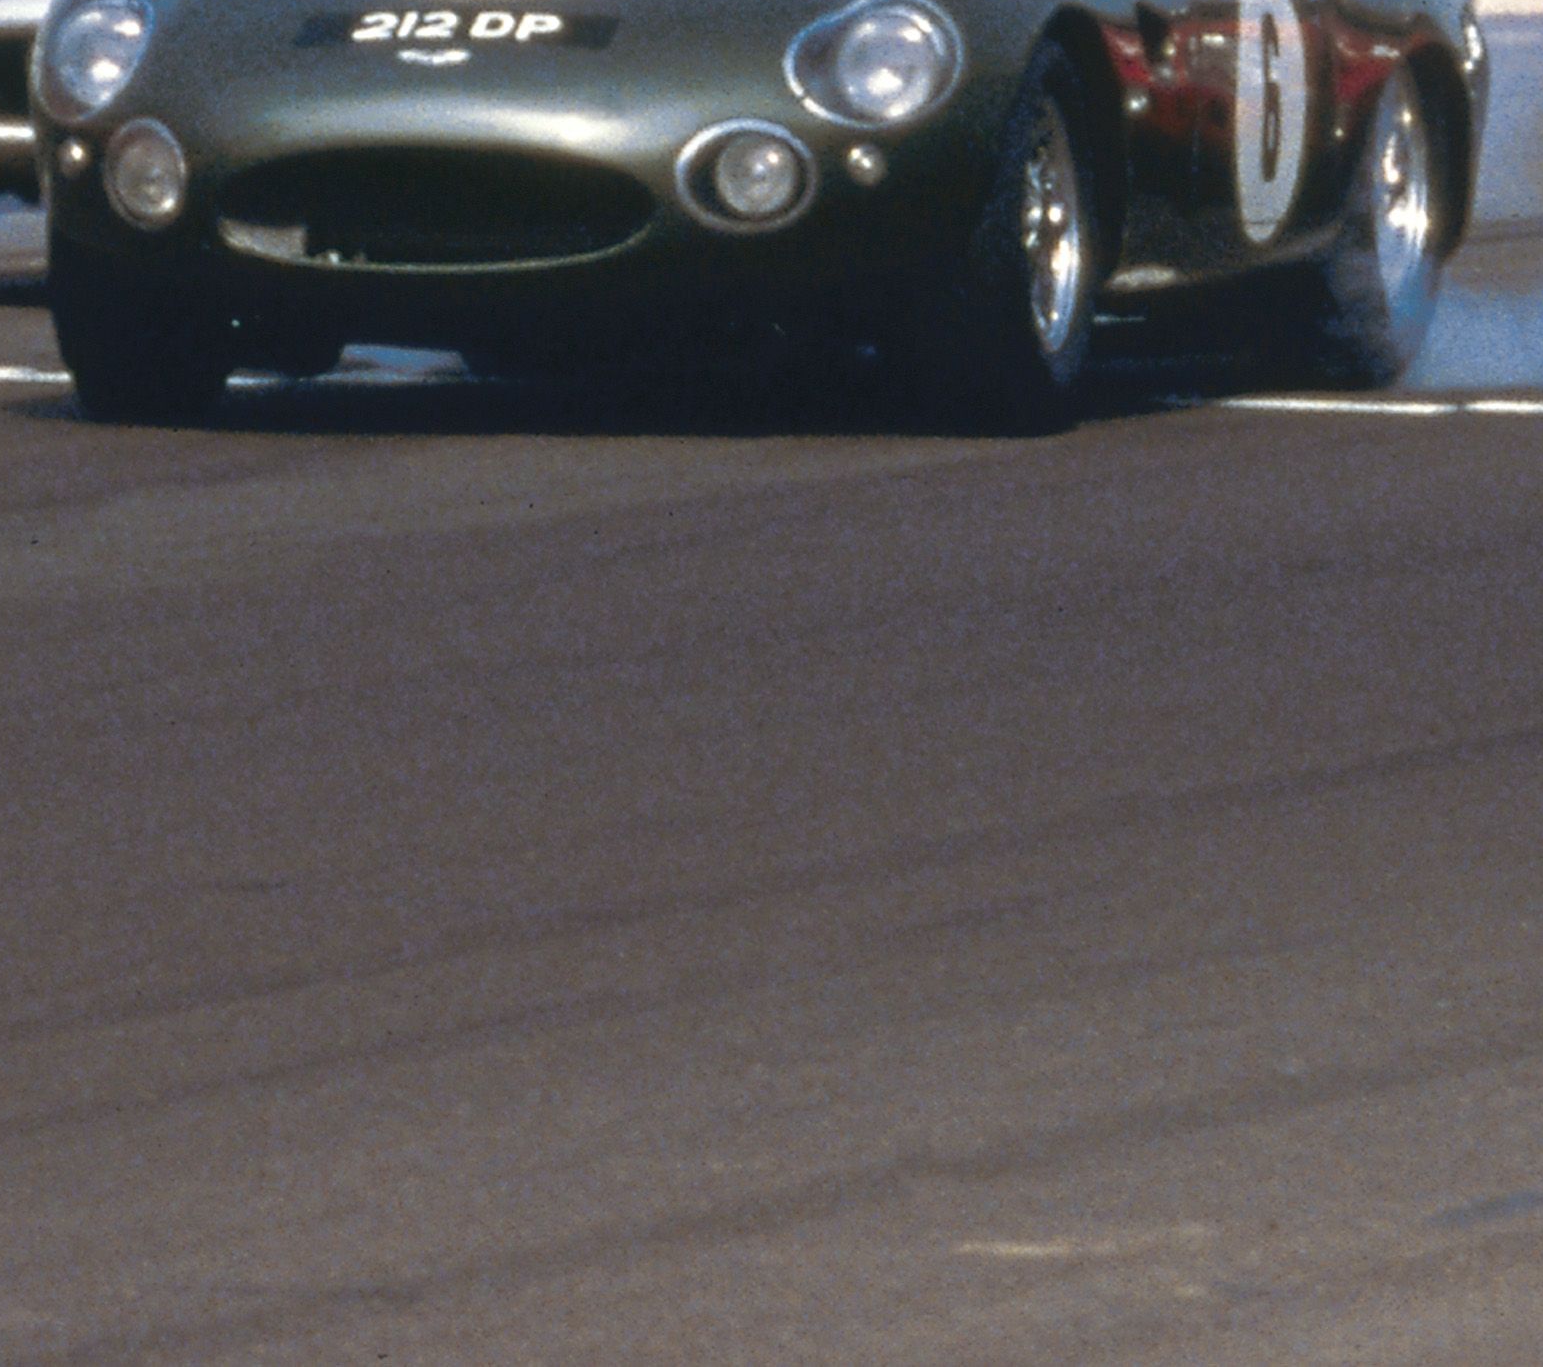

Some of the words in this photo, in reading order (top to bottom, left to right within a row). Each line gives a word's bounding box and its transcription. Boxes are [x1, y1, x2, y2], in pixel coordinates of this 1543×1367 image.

[351, 11, 460, 42] 212
[469, 11, 563, 43] DP
[1260, 12, 1282, 184] 6
